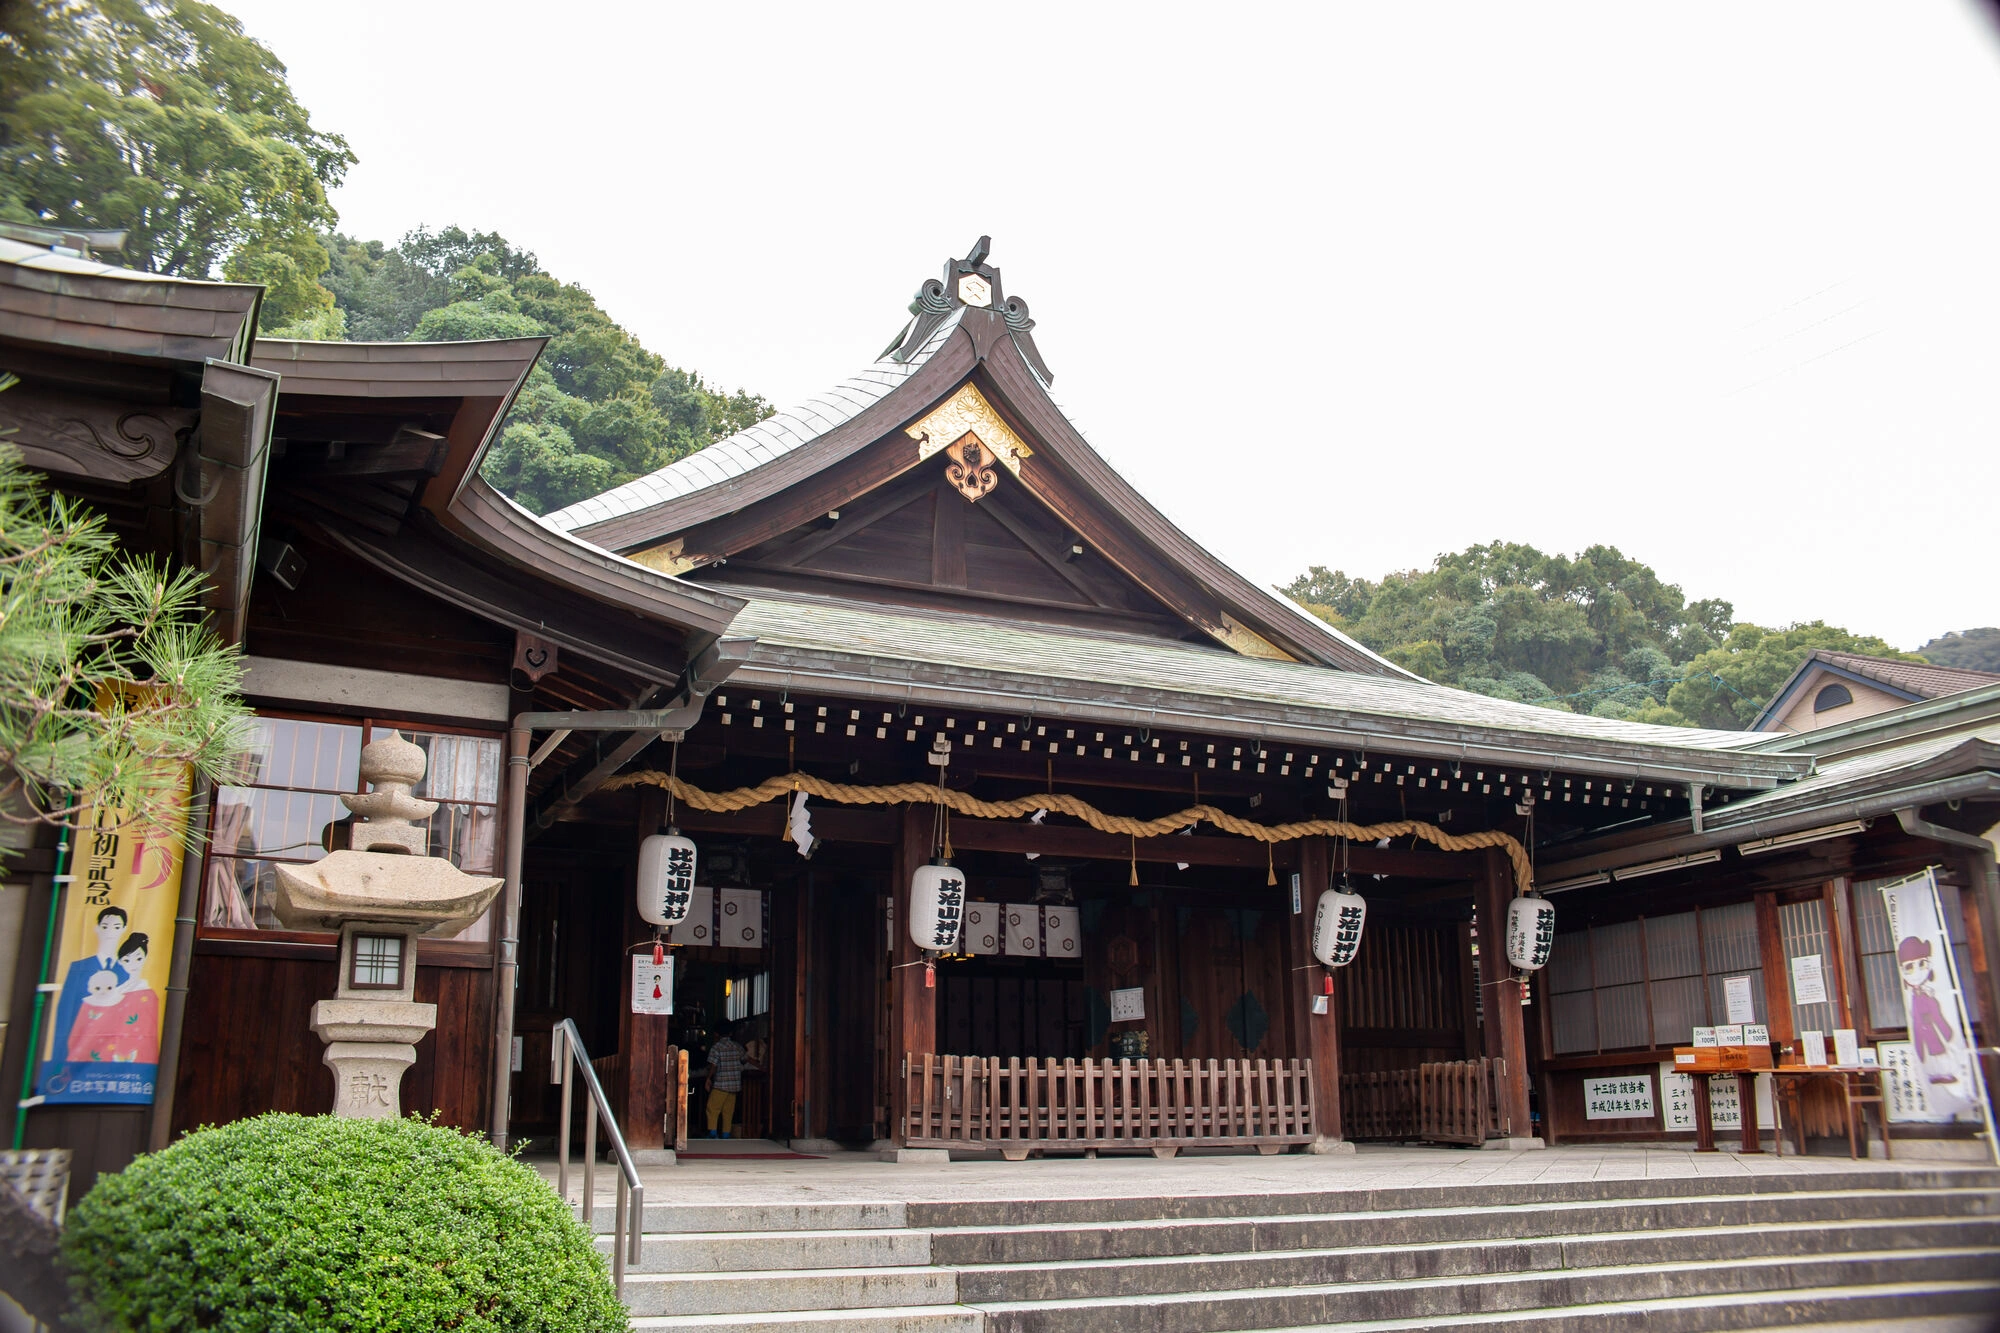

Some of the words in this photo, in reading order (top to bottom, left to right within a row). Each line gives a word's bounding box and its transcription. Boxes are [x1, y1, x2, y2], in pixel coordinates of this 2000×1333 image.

[660, 847, 694, 919] 比治山神社
[932, 878, 962, 945] 比治山神社
[1330, 906, 1362, 963] 比治山神社
[1531, 908, 1554, 965] 比治山神社
[70, 1080, 153, 1095] 日本写真館協会
[1619, 1080, 1646, 1095] 該当者
